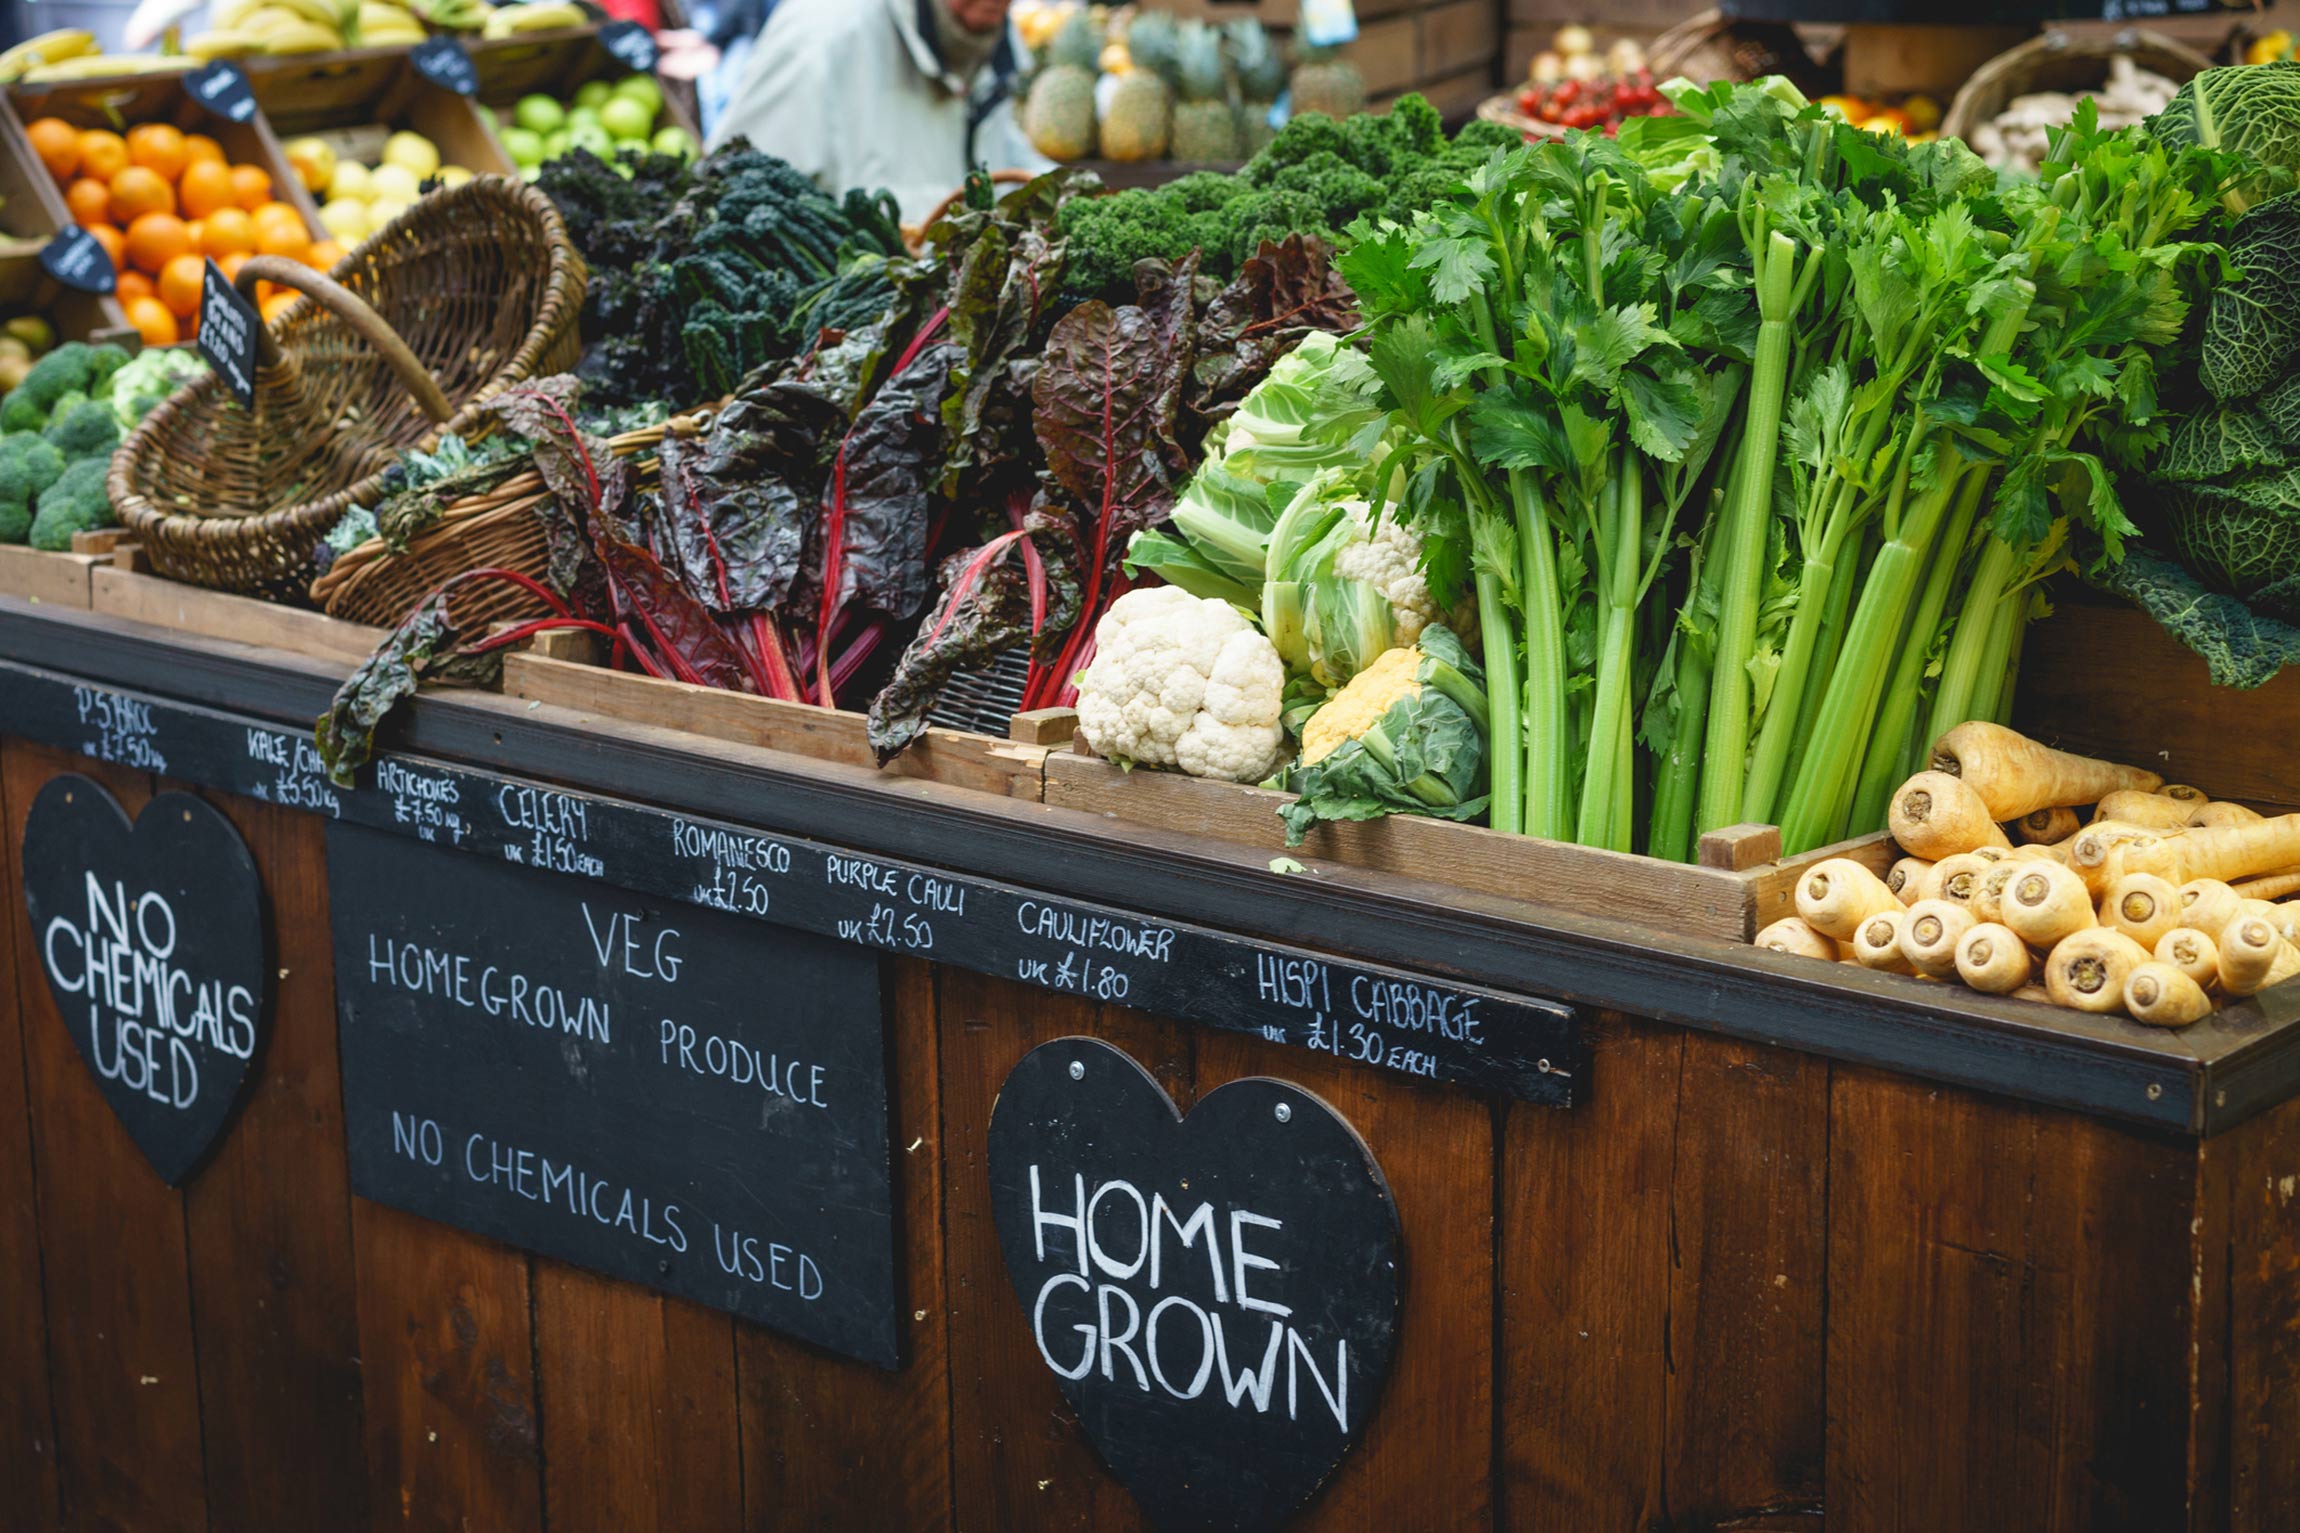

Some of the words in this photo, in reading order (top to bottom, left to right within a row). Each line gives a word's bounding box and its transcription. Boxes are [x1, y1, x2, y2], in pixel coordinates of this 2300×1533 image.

[247, 727, 290, 768] KALE
[378, 760, 460, 804] ARTICHOKES
[500, 785, 587, 841] CELERY
[672, 818, 791, 873] ROMANESCO
[85, 870, 176, 959] NO
[827, 855, 898, 896] PURPLE
[908, 874, 965, 916] CAULI
[582, 902, 683, 982] VEG
[838, 920, 863, 945] UK
[866, 903, 933, 948] £2.50
[1018, 901, 1176, 963] CAULIFLOWER
[45, 916, 256, 1059] CHEMICALS
[1018, 958, 1049, 985] UK
[1055, 951, 1129, 1000] £1.80
[1258, 953, 1331, 1012] HISPI
[1352, 976, 1485, 1045] CABBAGE
[91, 1004, 198, 1109] USED
[660, 1019, 828, 1108] PRODUCE
[1308, 1012, 1383, 1064] £1.30
[1387, 1047, 1437, 1078] EACH
[392, 1111, 443, 1165] NO
[466, 1134, 688, 1252] CHEMICALS
[714, 1224, 823, 1300] USED
[1030, 1164, 1293, 1317] HOME
[1033, 1273, 1348, 1434] GROWN
